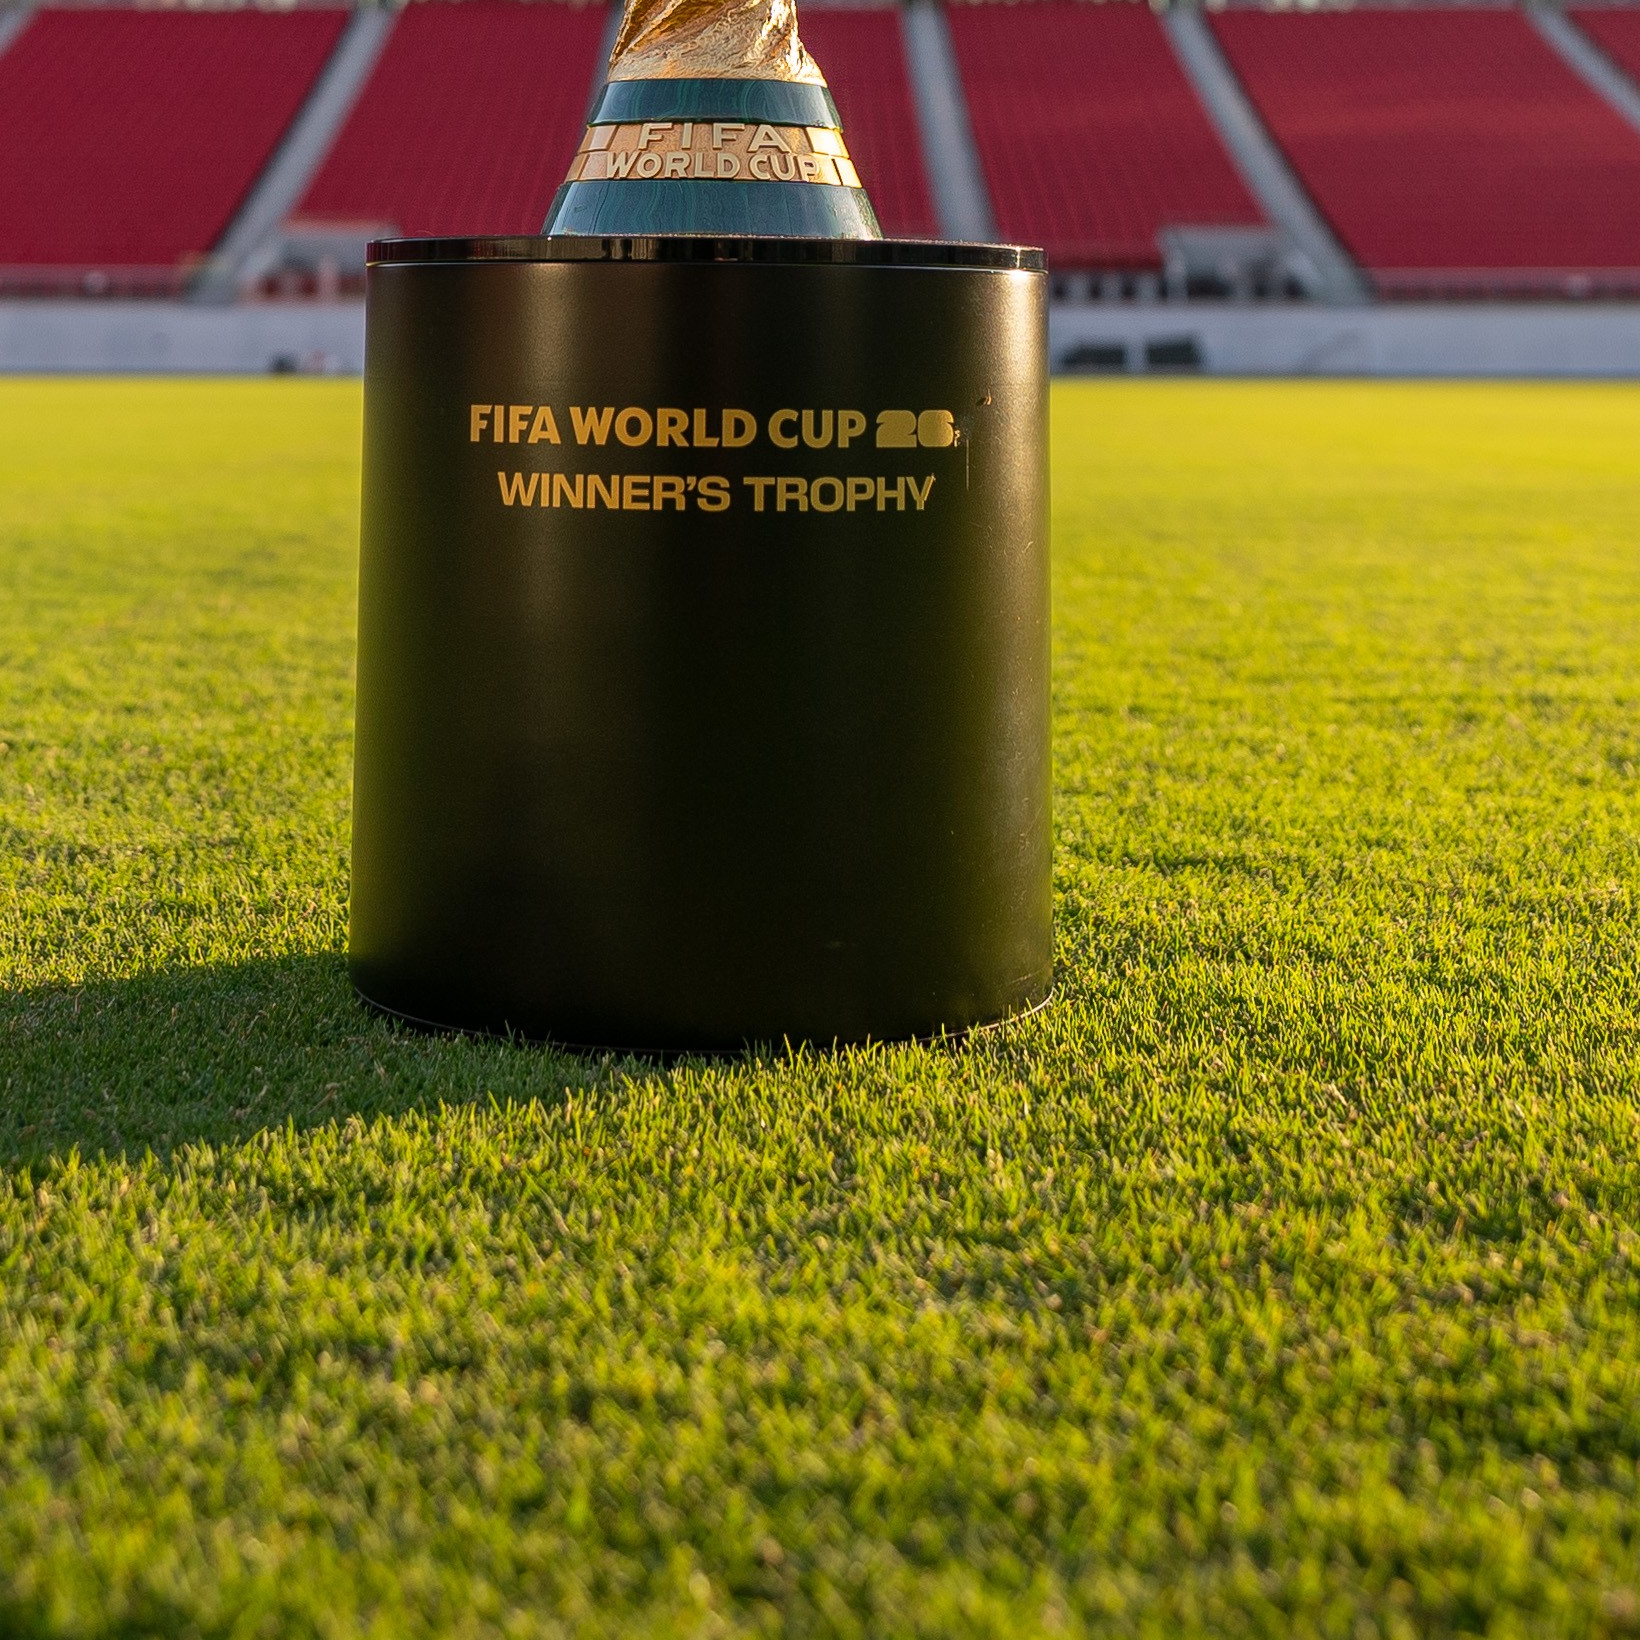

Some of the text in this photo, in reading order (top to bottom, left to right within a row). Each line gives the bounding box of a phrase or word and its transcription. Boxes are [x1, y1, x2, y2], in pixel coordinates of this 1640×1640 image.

[638, 122, 791, 153] FIFA
[606, 151, 821, 181] WORLD CUP
[469, 404, 561, 444] FIFA
[568, 406, 756, 449] WORLD
[768, 408, 867, 448] CUP
[875, 409, 955, 448] 26
[497, 471, 936, 513] WINNER'S TROPHY
